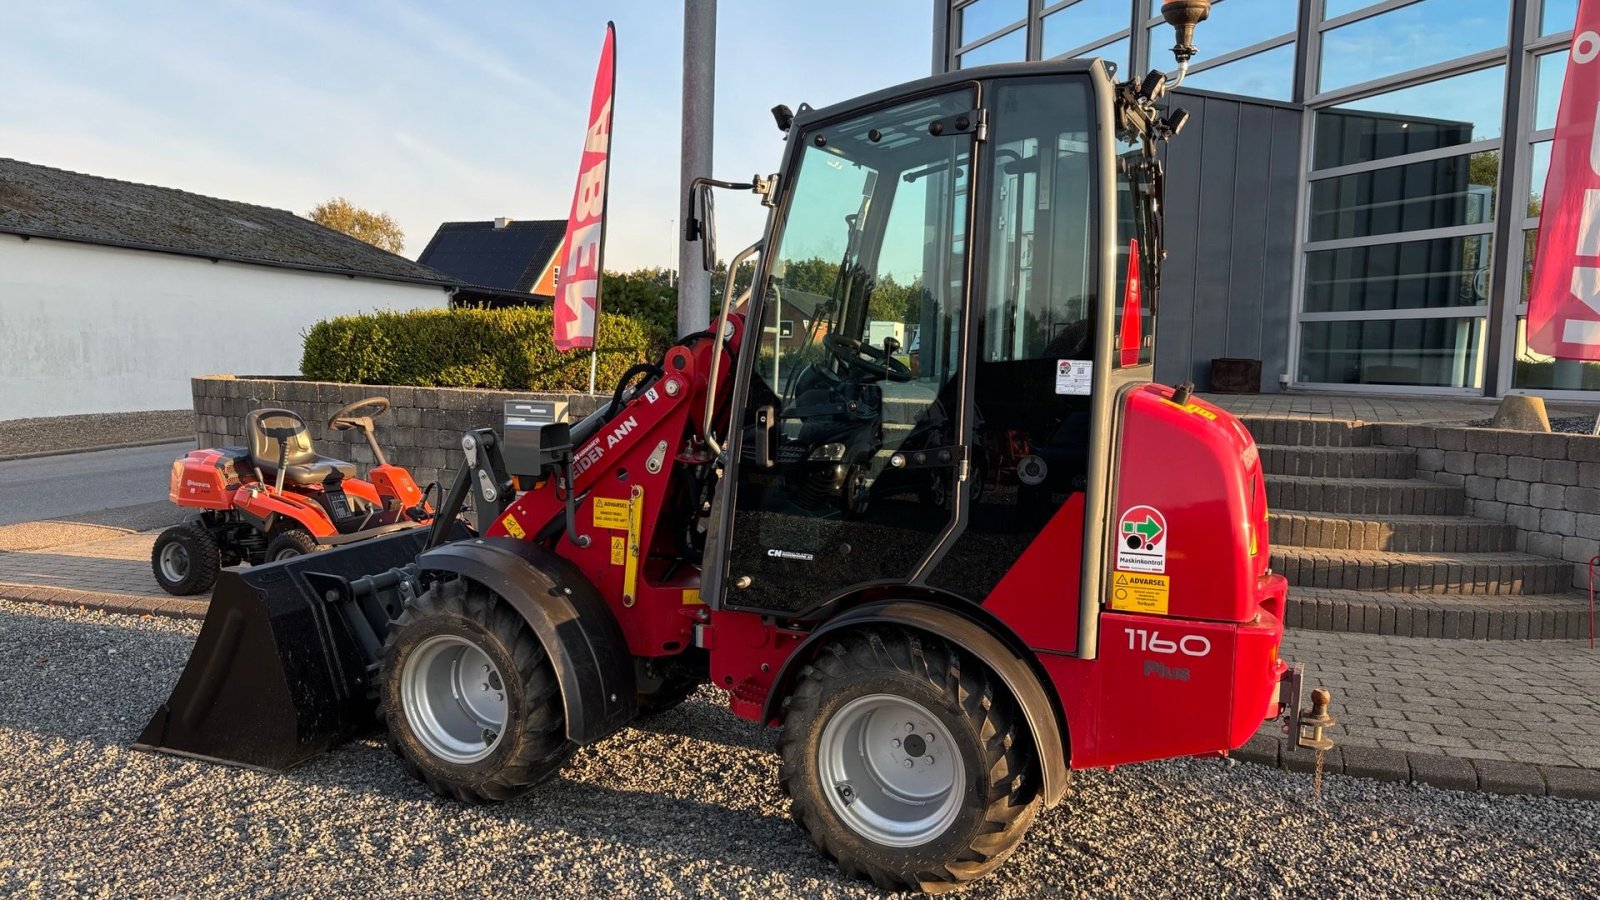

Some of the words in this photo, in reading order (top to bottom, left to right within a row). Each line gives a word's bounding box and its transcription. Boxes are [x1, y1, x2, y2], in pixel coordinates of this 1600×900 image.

[767, 549, 782, 557] CN
[1119, 557, 1163, 566] Maskinkontrol
[1129, 577, 1166, 587] ADVARSEL
[1124, 627, 1211, 657] 1160
[1143, 659, 1191, 682] Plus
